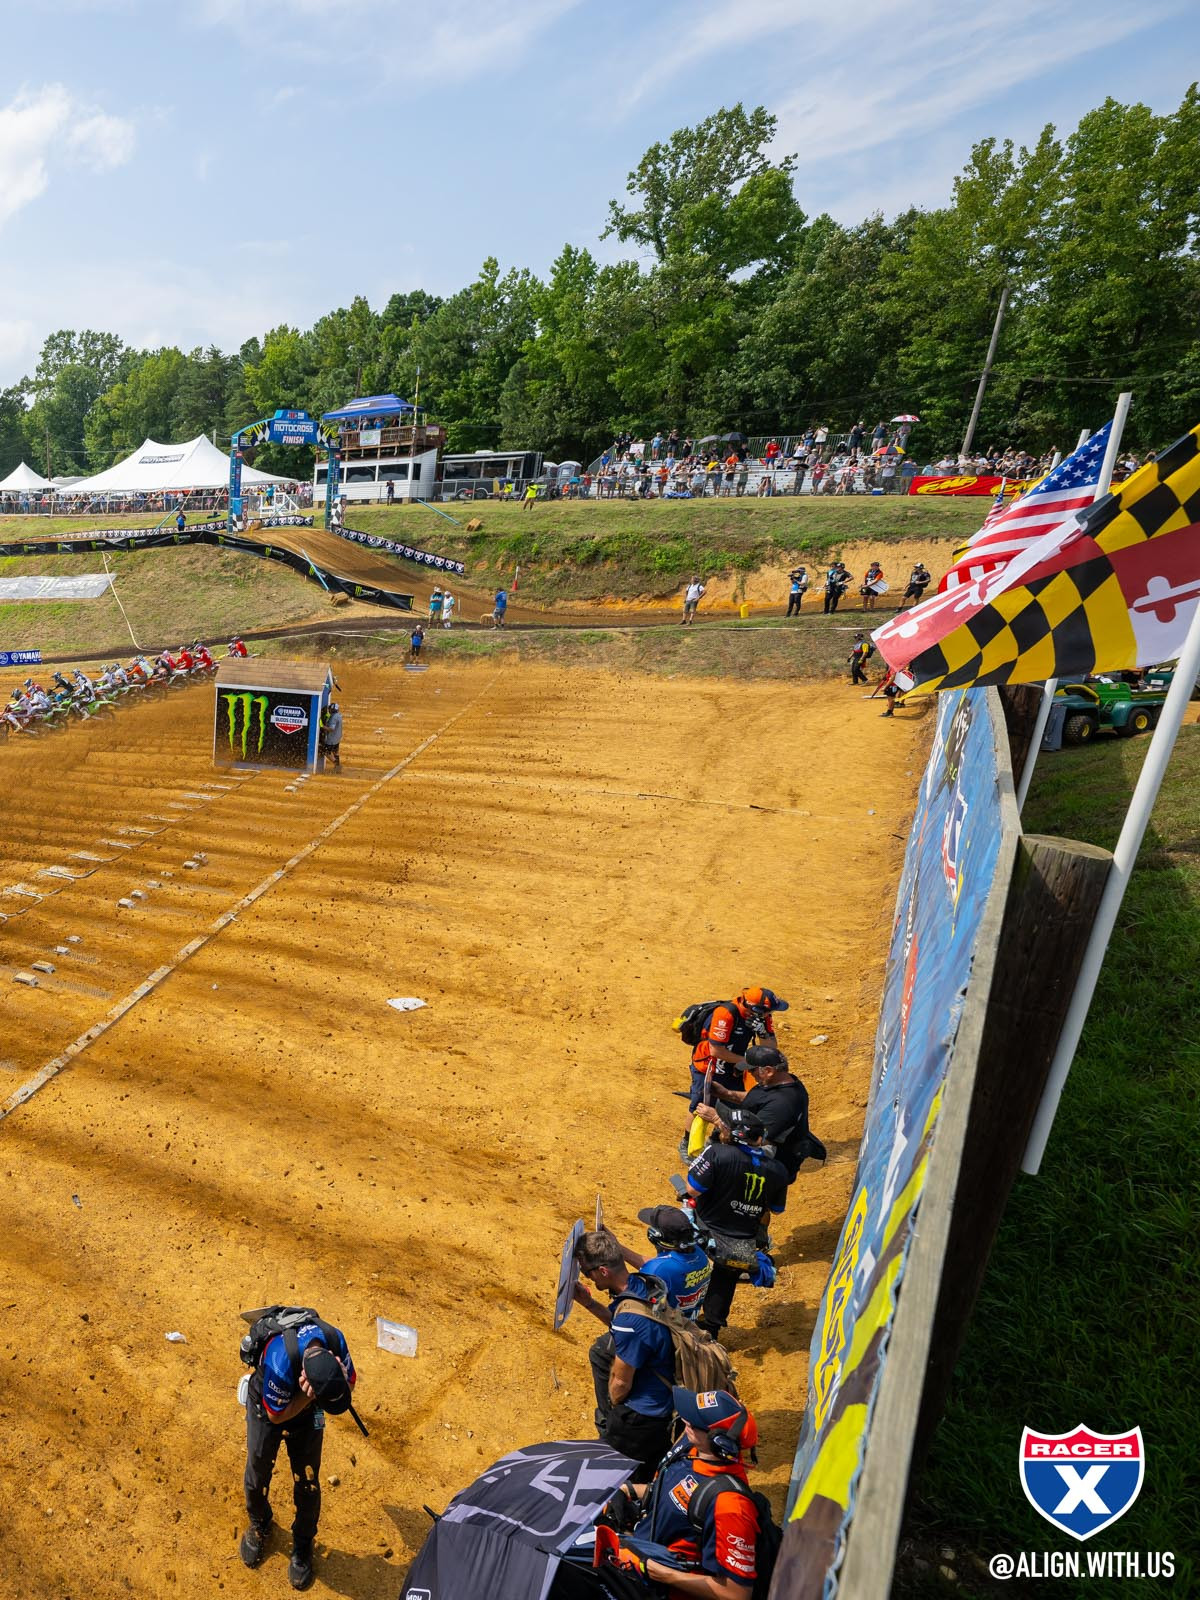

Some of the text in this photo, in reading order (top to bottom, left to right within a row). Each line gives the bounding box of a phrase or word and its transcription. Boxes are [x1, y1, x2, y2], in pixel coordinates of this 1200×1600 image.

[273, 423, 314, 433] MOTOCROSS
[282, 435, 305, 444] FINISH
[18, 651, 41, 661] YAMAH
